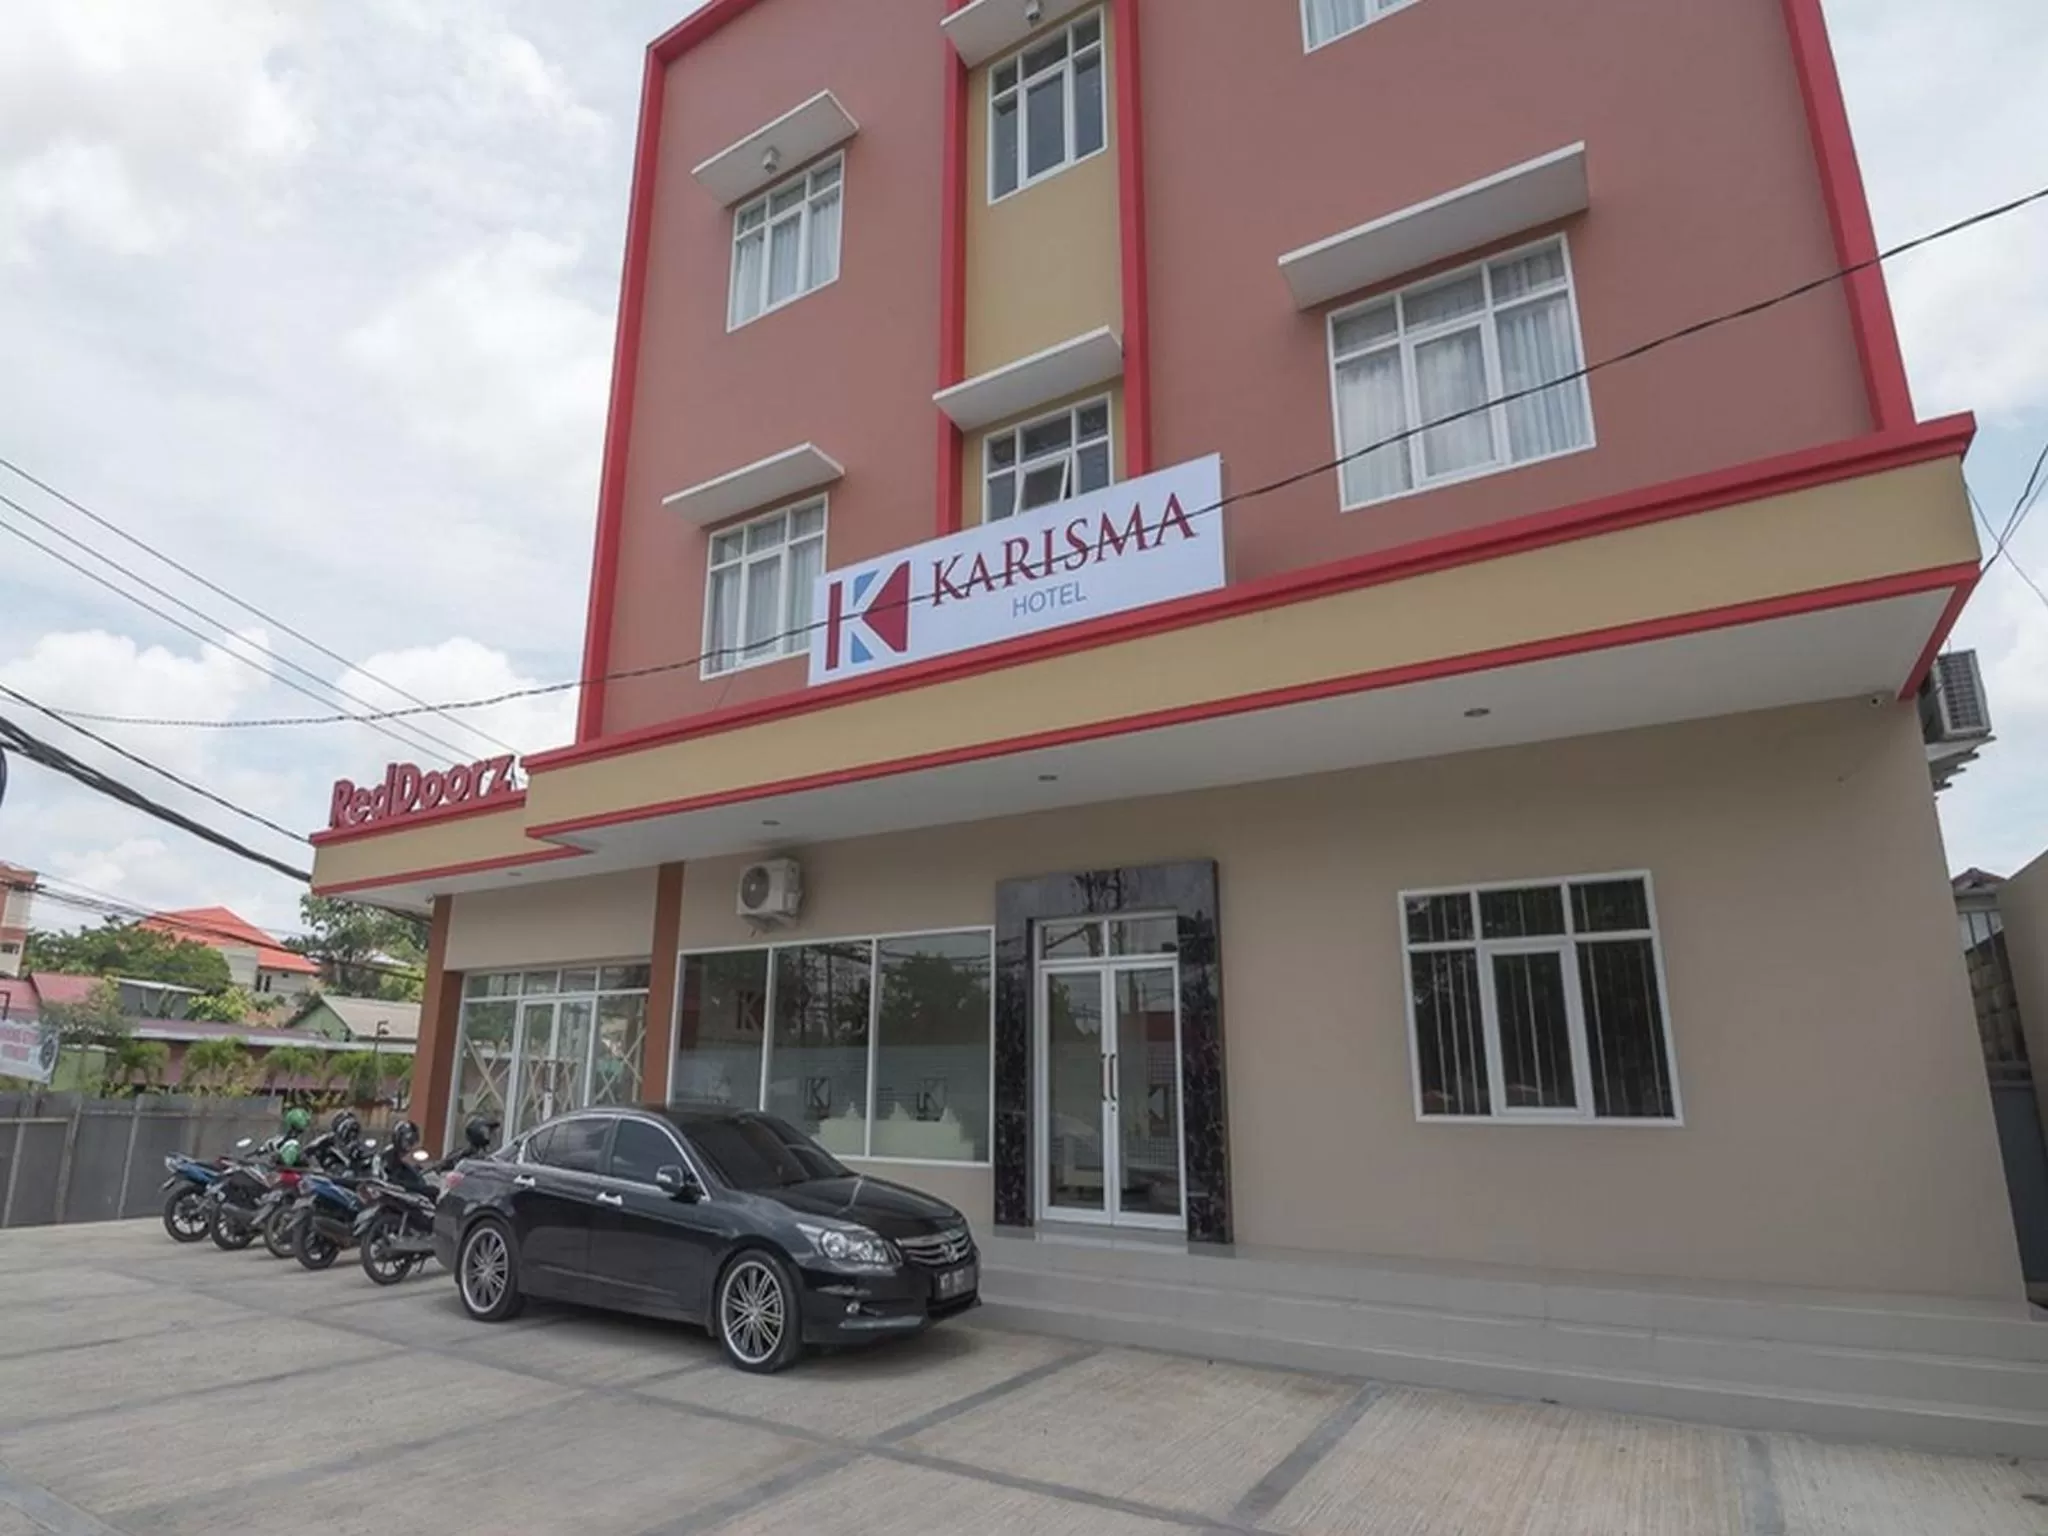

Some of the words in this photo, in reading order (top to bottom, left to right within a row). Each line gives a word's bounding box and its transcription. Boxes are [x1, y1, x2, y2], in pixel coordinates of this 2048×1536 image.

[931, 492, 1197, 607] KARISMA
[1012, 581, 1087, 618] HOTEL
[330, 754, 515, 829] RedDoorz
